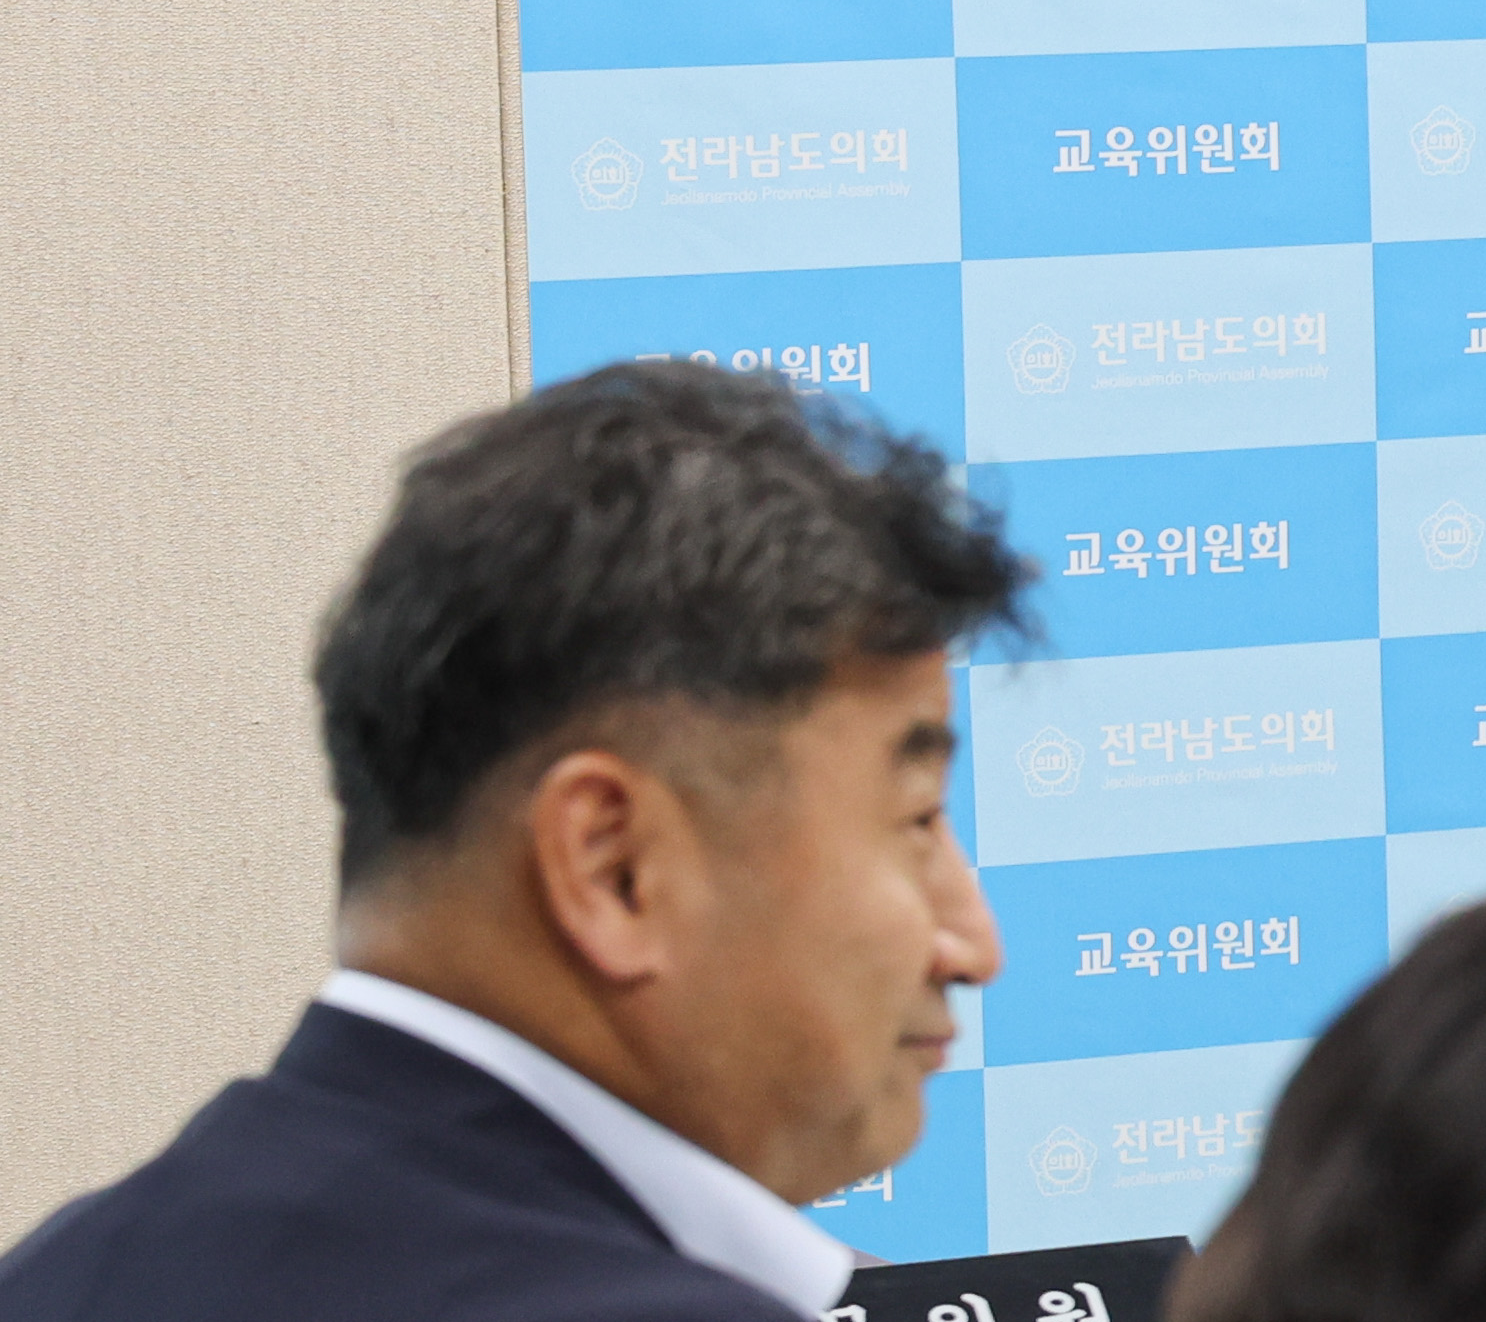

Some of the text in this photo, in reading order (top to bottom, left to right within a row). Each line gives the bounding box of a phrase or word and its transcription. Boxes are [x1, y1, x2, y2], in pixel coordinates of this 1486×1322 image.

[662, 130, 907, 182] 전라남도의회
[1055, 123, 1280, 177] 교육위원회
[1094, 314, 1326, 365] 전라남도의회
[1064, 522, 1289, 578] 교육위원회
[1102, 710, 1334, 766] 전라남도의회
[1077, 918, 1300, 977] 교육위원회
[1114, 1112, 1264, 1164] 전라남도
